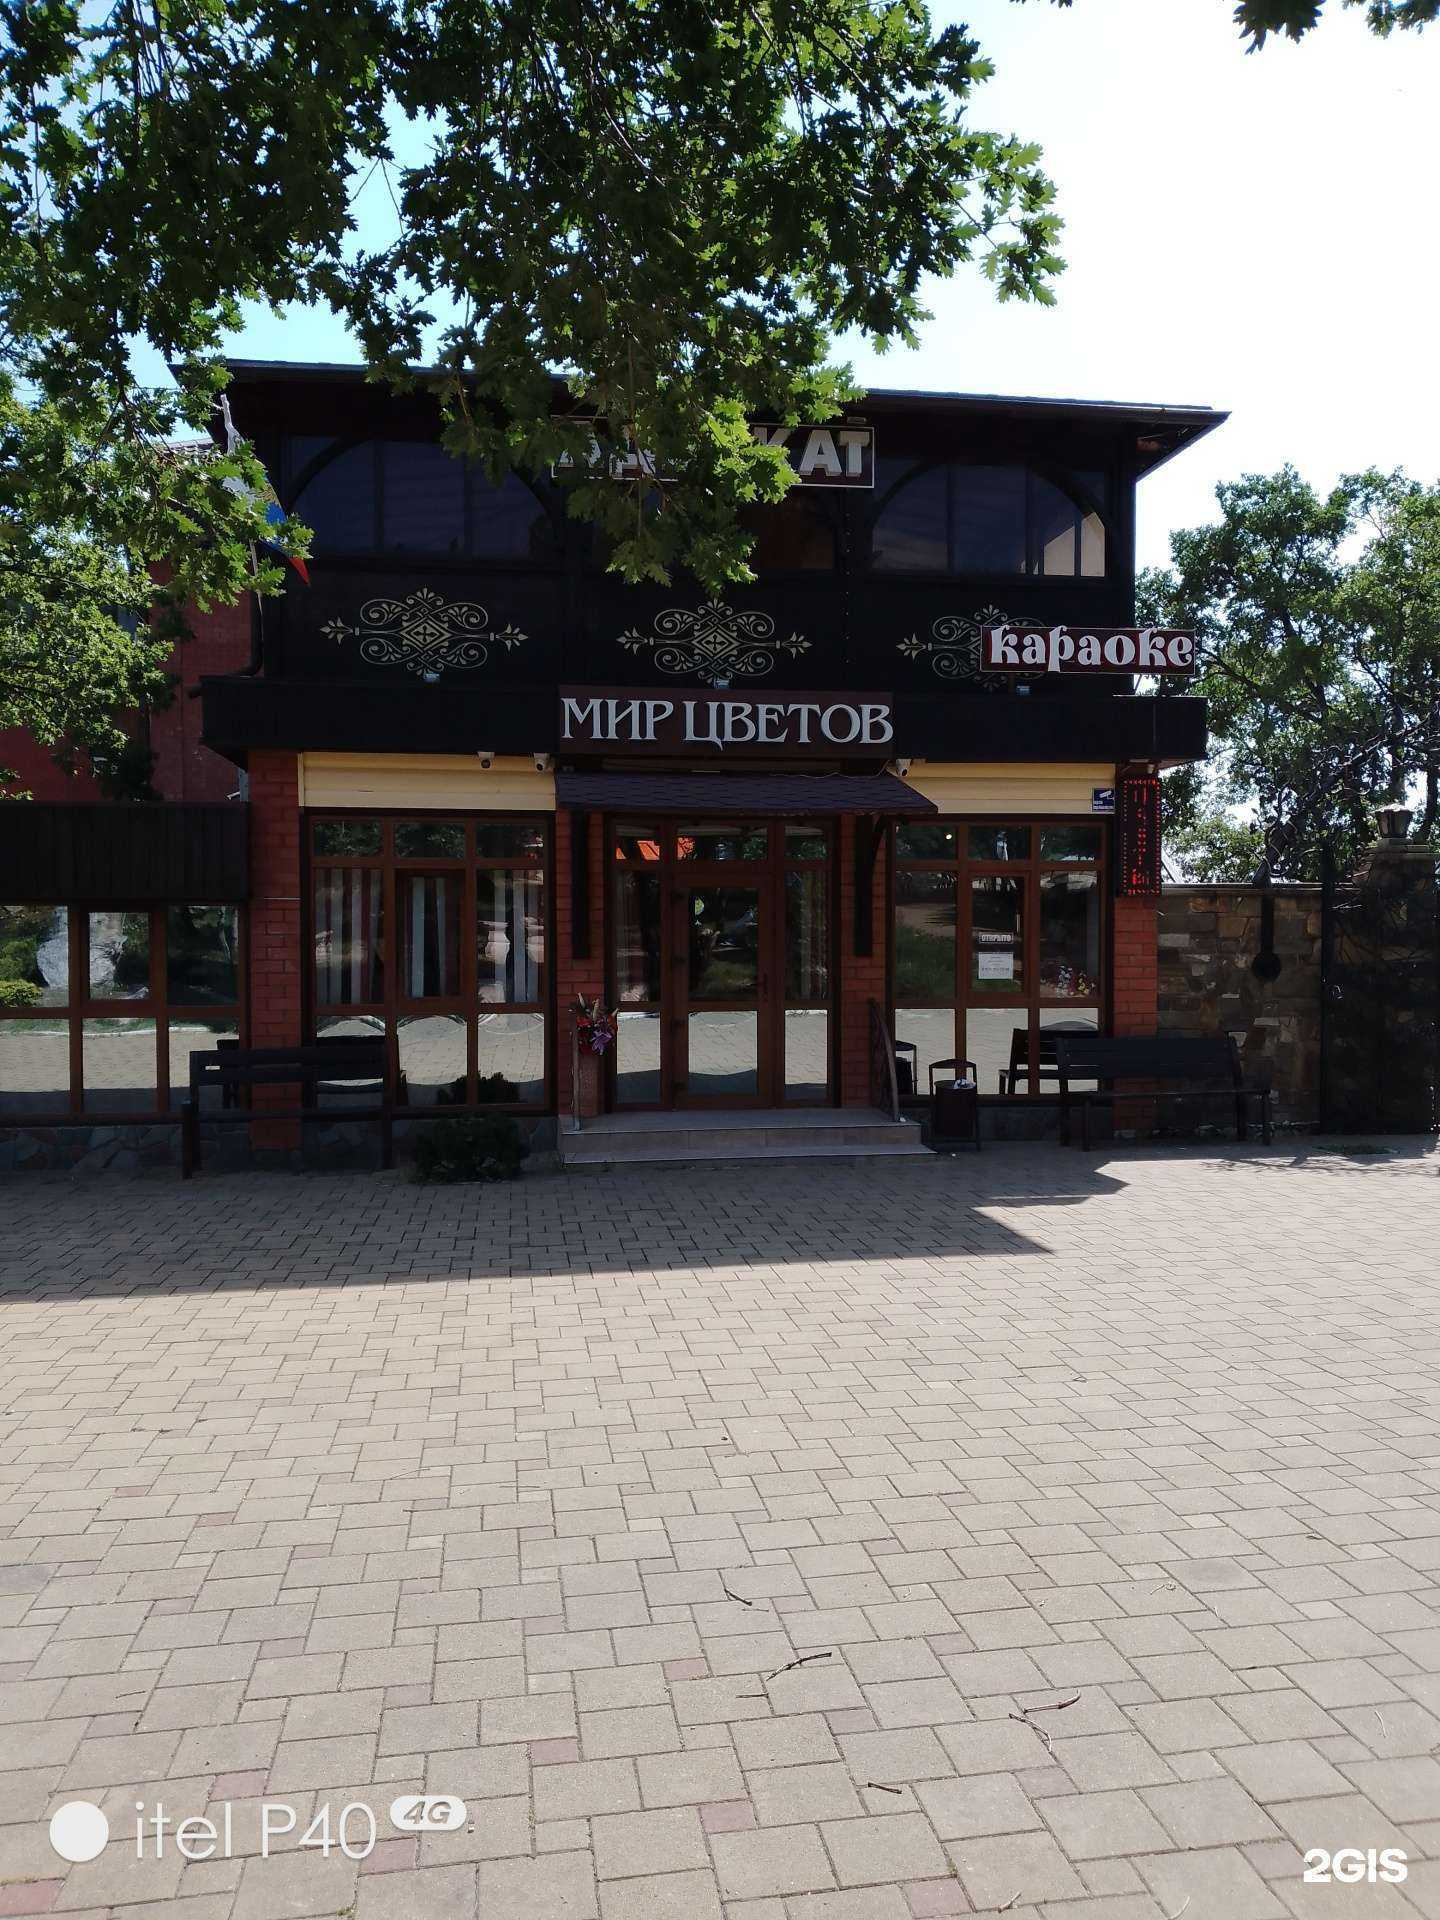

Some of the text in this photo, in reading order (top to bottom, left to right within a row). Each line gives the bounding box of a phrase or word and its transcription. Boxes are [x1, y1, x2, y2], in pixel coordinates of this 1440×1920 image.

[990, 624, 1193, 672] караоке
[561, 697, 894, 751] МИР ЦВЕТОВ
